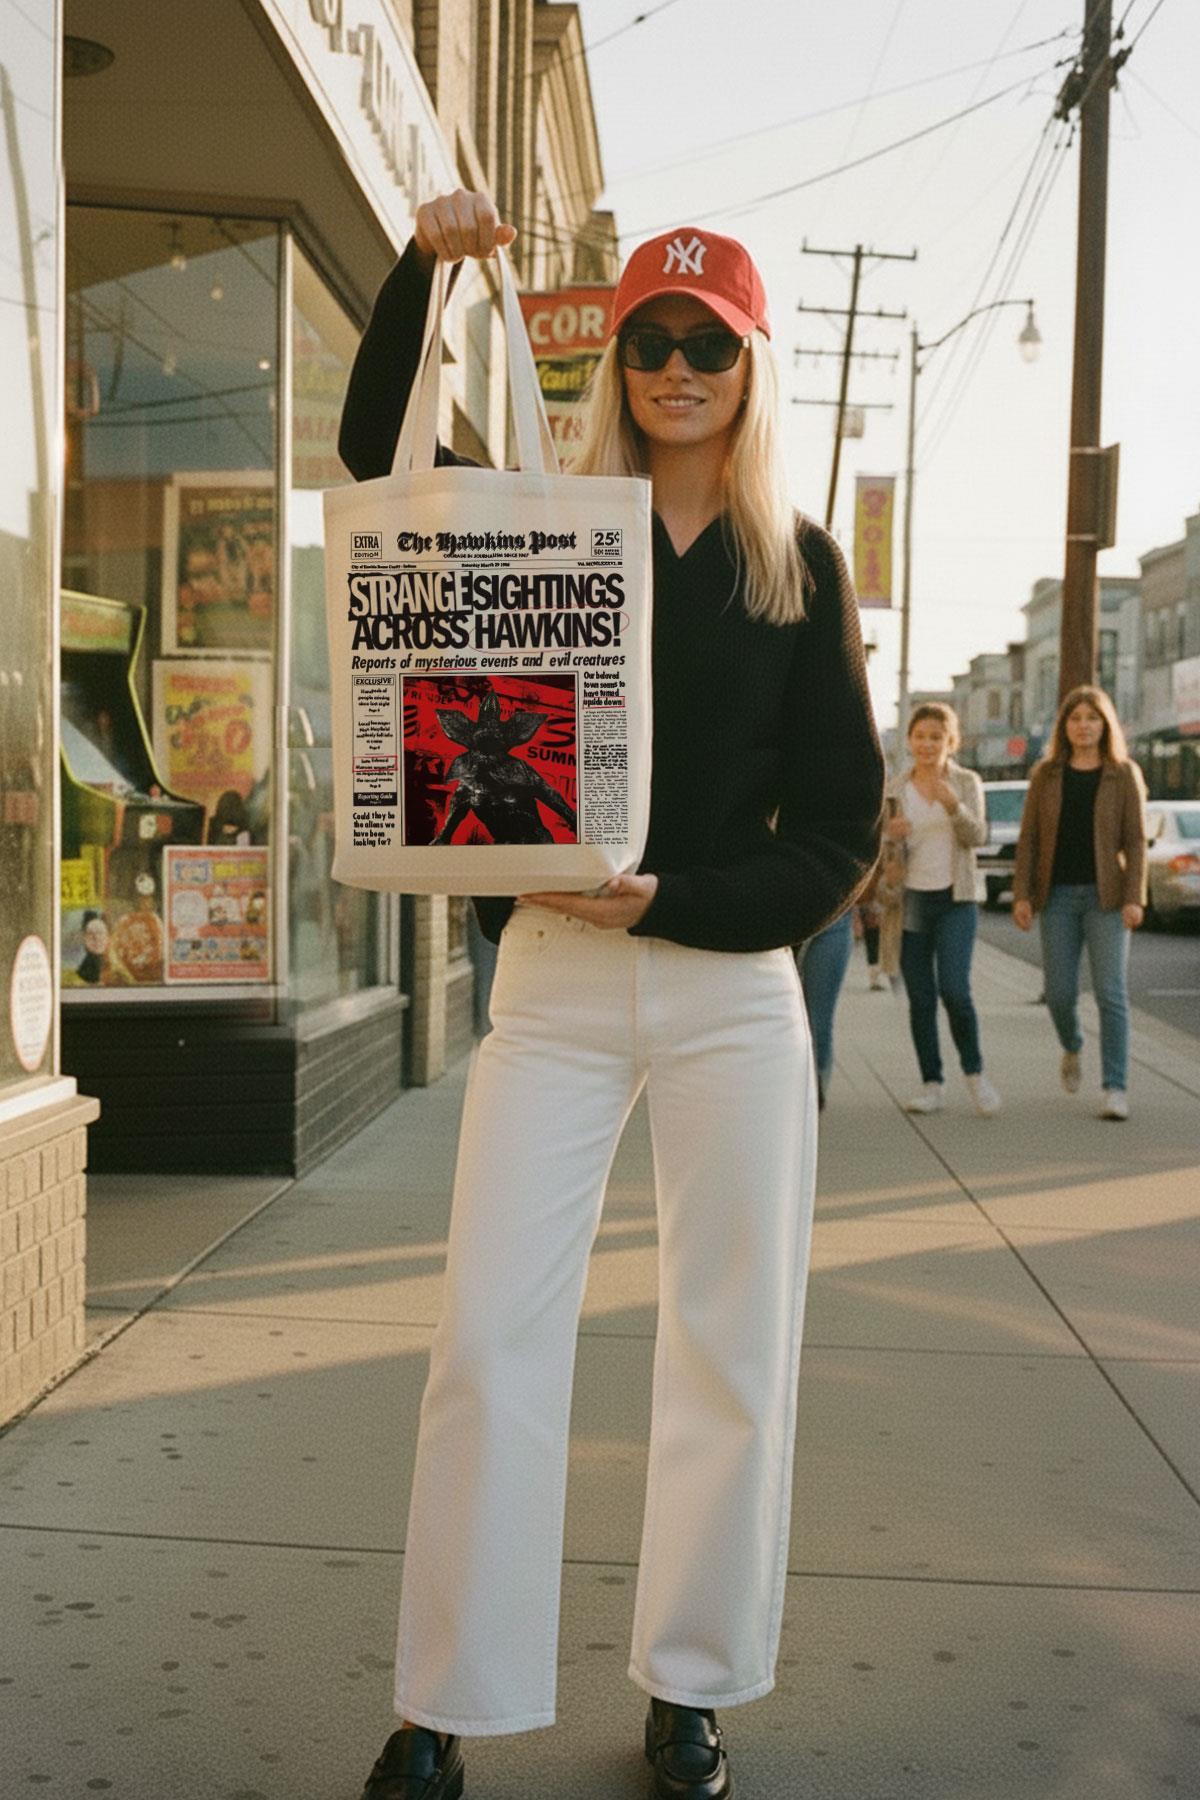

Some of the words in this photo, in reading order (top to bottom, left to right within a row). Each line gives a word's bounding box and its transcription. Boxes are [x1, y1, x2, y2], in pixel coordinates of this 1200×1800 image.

[662, 236, 707, 276] NY
[354, 536, 379, 548] EXTRA
[397, 531, 433, 555] The
[436, 530, 526, 556] Hawkins
[528, 530, 577, 554] Post
[594, 531, 620, 546] 25¢
[350, 572, 472, 616] STRANGE
[473, 573, 625, 610] SIGHTINGS
[352, 614, 470, 650] ACROSS
[475, 611, 620, 648] HAWKINS!
[352, 656, 396, 672] Reports
[400, 653, 412, 669] of
[415, 655, 477, 672] mysterious
[480, 656, 518, 668] events
[522, 652, 543, 667] and
[550, 652, 571, 666] evil
[572, 654, 625, 666] creatures
[583, 697, 603, 707] upside
[604, 697, 622, 705] down
[353, 812, 370, 820] Could
[372, 811, 386, 820] they
[353, 838, 376, 847] looking
